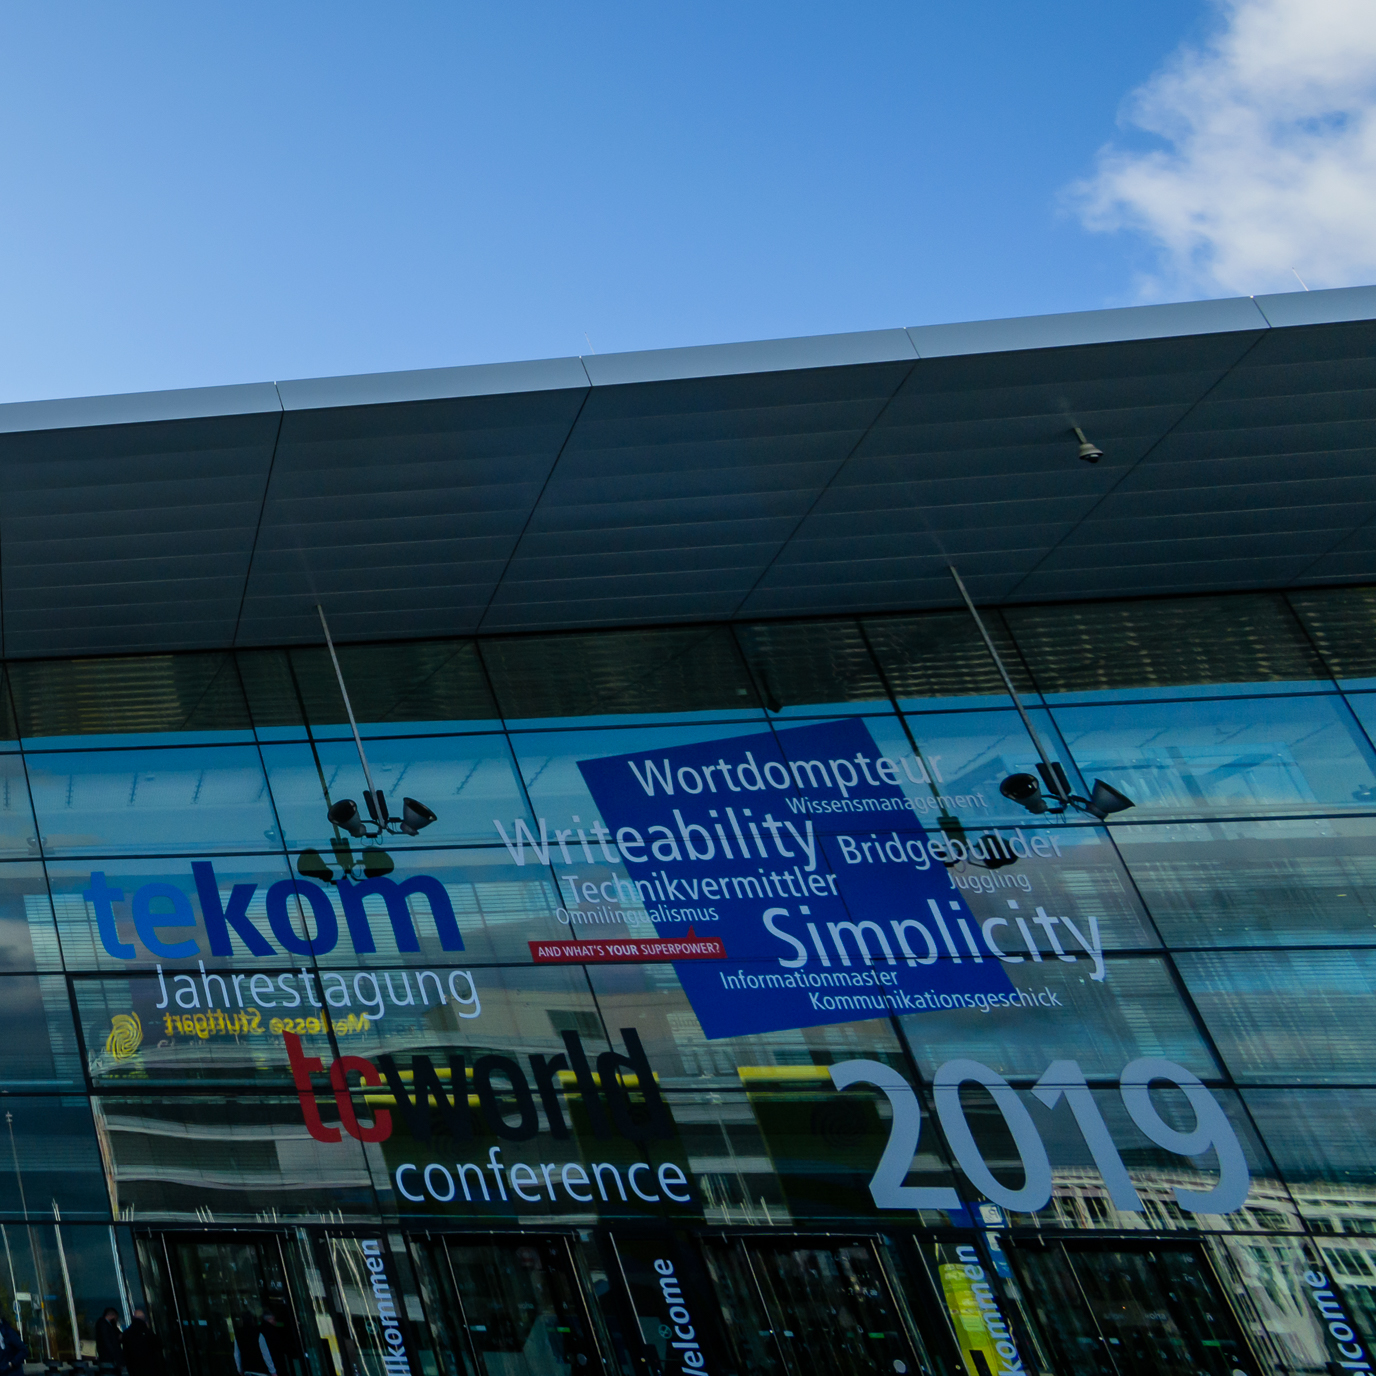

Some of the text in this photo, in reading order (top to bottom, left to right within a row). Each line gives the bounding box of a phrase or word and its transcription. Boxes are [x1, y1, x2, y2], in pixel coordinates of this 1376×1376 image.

[627, 751, 946, 797] Wortdompteur
[786, 791, 988, 815] Wissensmanagement
[493, 807, 817, 872] Writeability
[837, 827, 1063, 871] Bridgebuilder
[561, 866, 838, 904] Technikvermittler
[950, 871, 1032, 894] Juggling
[82, 861, 466, 960] tekom
[555, 905, 719, 928] Omnilingualismus
[538, 942, 721, 958] AND WHAT'S YOUR SUPERPOWER?
[762, 898, 1106, 982] Simplicity
[156, 960, 482, 1019] Jahrestagung
[719, 968, 899, 990] Informationmaster
[809, 987, 1064, 1013] Kommunikationsgeschick
[282, 1027, 675, 1143] tcworld
[829, 1056, 1252, 1215] 2019
[395, 1147, 691, 1206] conference
